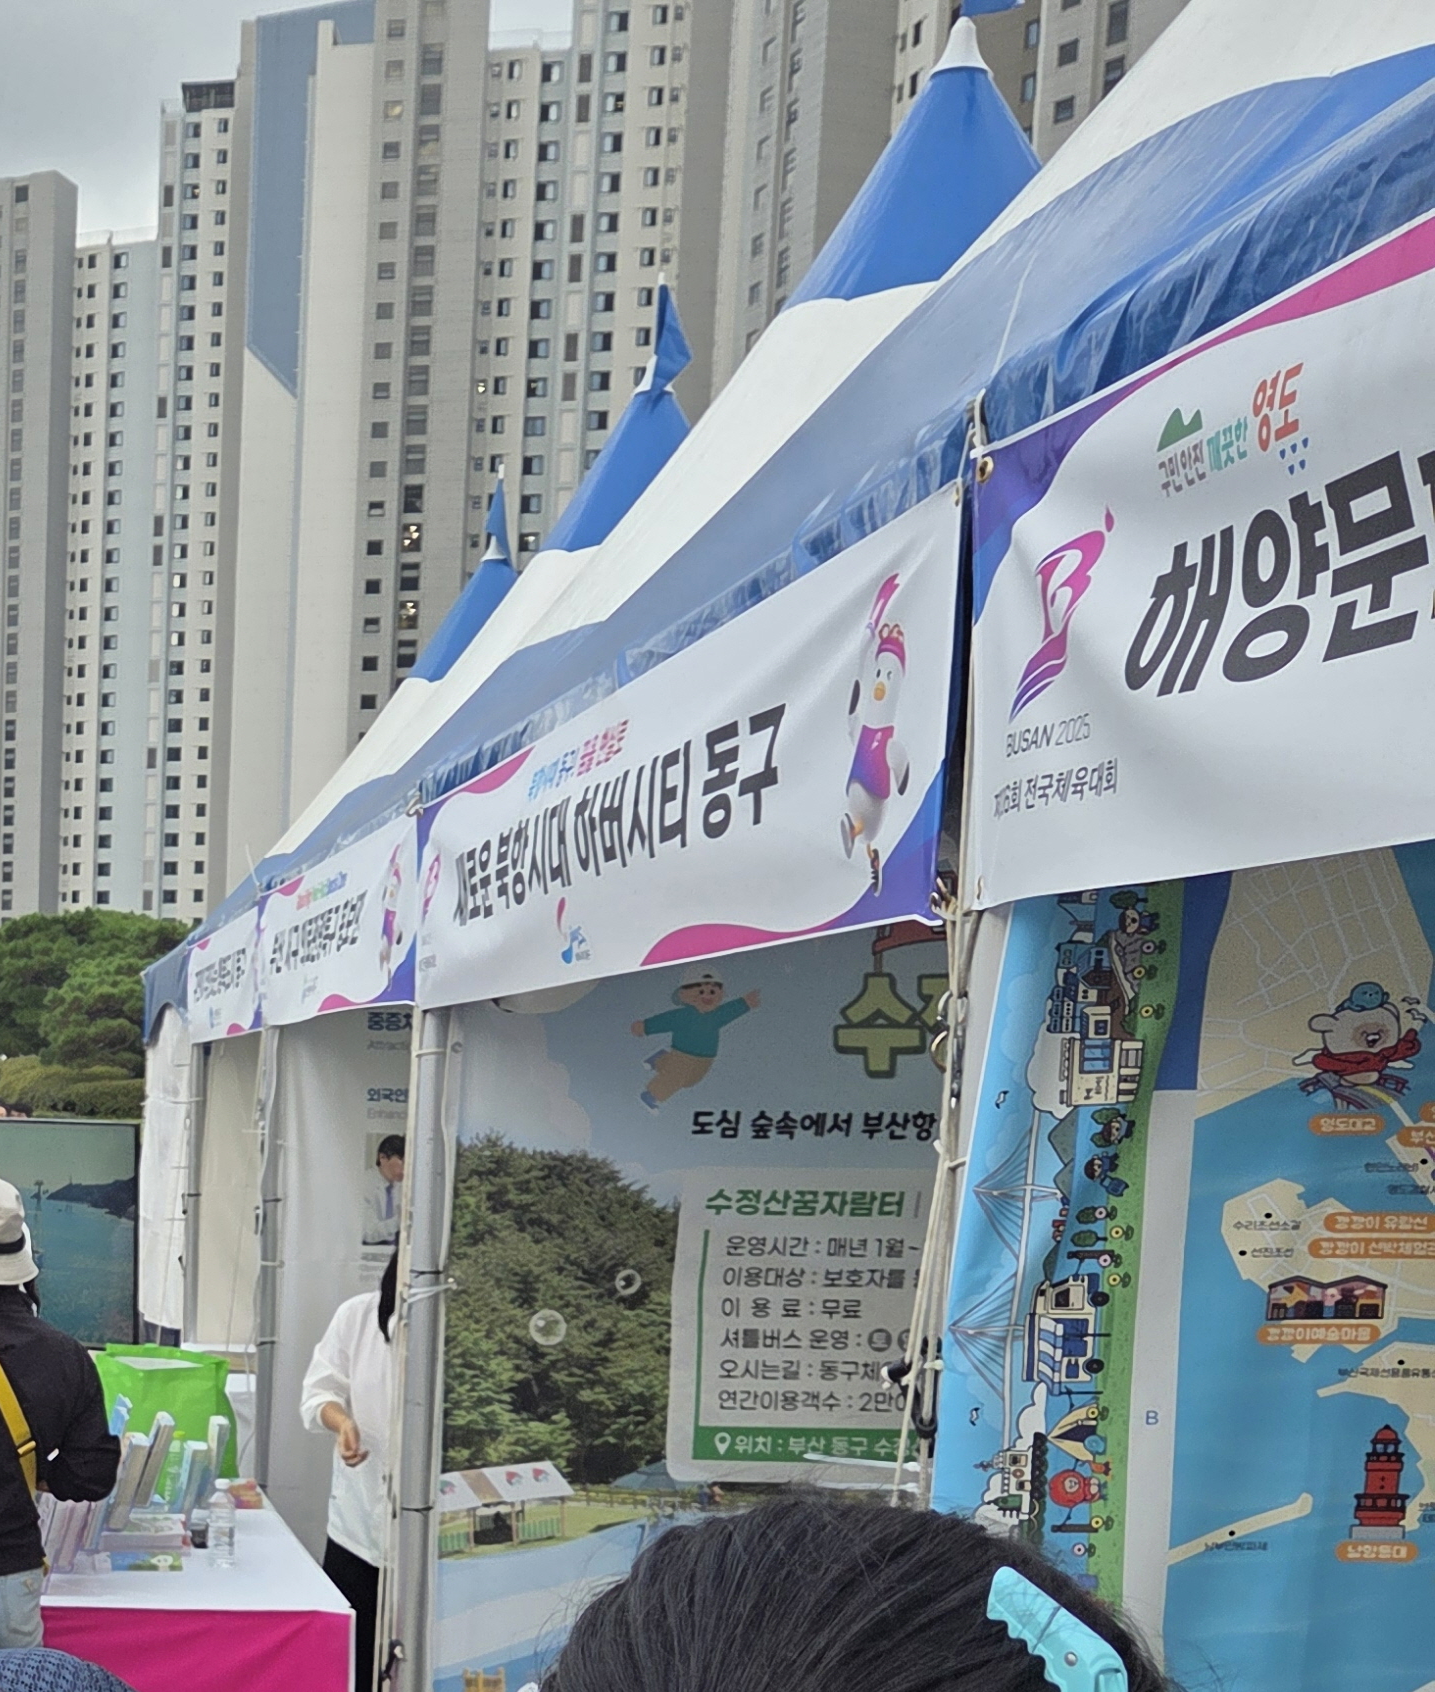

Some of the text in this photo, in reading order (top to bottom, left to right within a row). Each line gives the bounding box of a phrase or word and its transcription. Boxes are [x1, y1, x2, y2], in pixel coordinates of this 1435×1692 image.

[1159, 438, 1206, 498] 국민안전
[1252, 362, 1304, 452] 영도
[1124, 450, 1435, 698] 해양문
[1006, 713, 1091, 758] BUSAN 2025
[1024, 757, 1118, 810] 전국체육대회
[453, 703, 787, 926] 새로운 북항시대 하버시티 동구
[691, 1110, 938, 1141] 도심 숲속에서 부산항
[1319, 1117, 1377, 1132] 영도대교
[705, 1189, 906, 1218] 수정산꿈자람터
[725, 1235, 905, 1257] 운영시간 매년 1월
[723, 1266, 806, 1287] 이용대상
[823, 1268, 906, 1288] 보호자를
[821, 1299, 862, 1319] 무료
[720, 1328, 802, 1350] 셔틀버스
[809, 1328, 849, 1350] 운영
[718, 1359, 891, 1381] 오시는길 동구체
[718, 1390, 842, 1412] 연간이용객수
[1146, 1411, 1159, 1425] B
[735, 1435, 773, 1455] 위치
[788, 1437, 826, 1455] 부산
[831, 1437, 868, 1456] 동구
[1346, 1544, 1408, 1559] 남항등대
